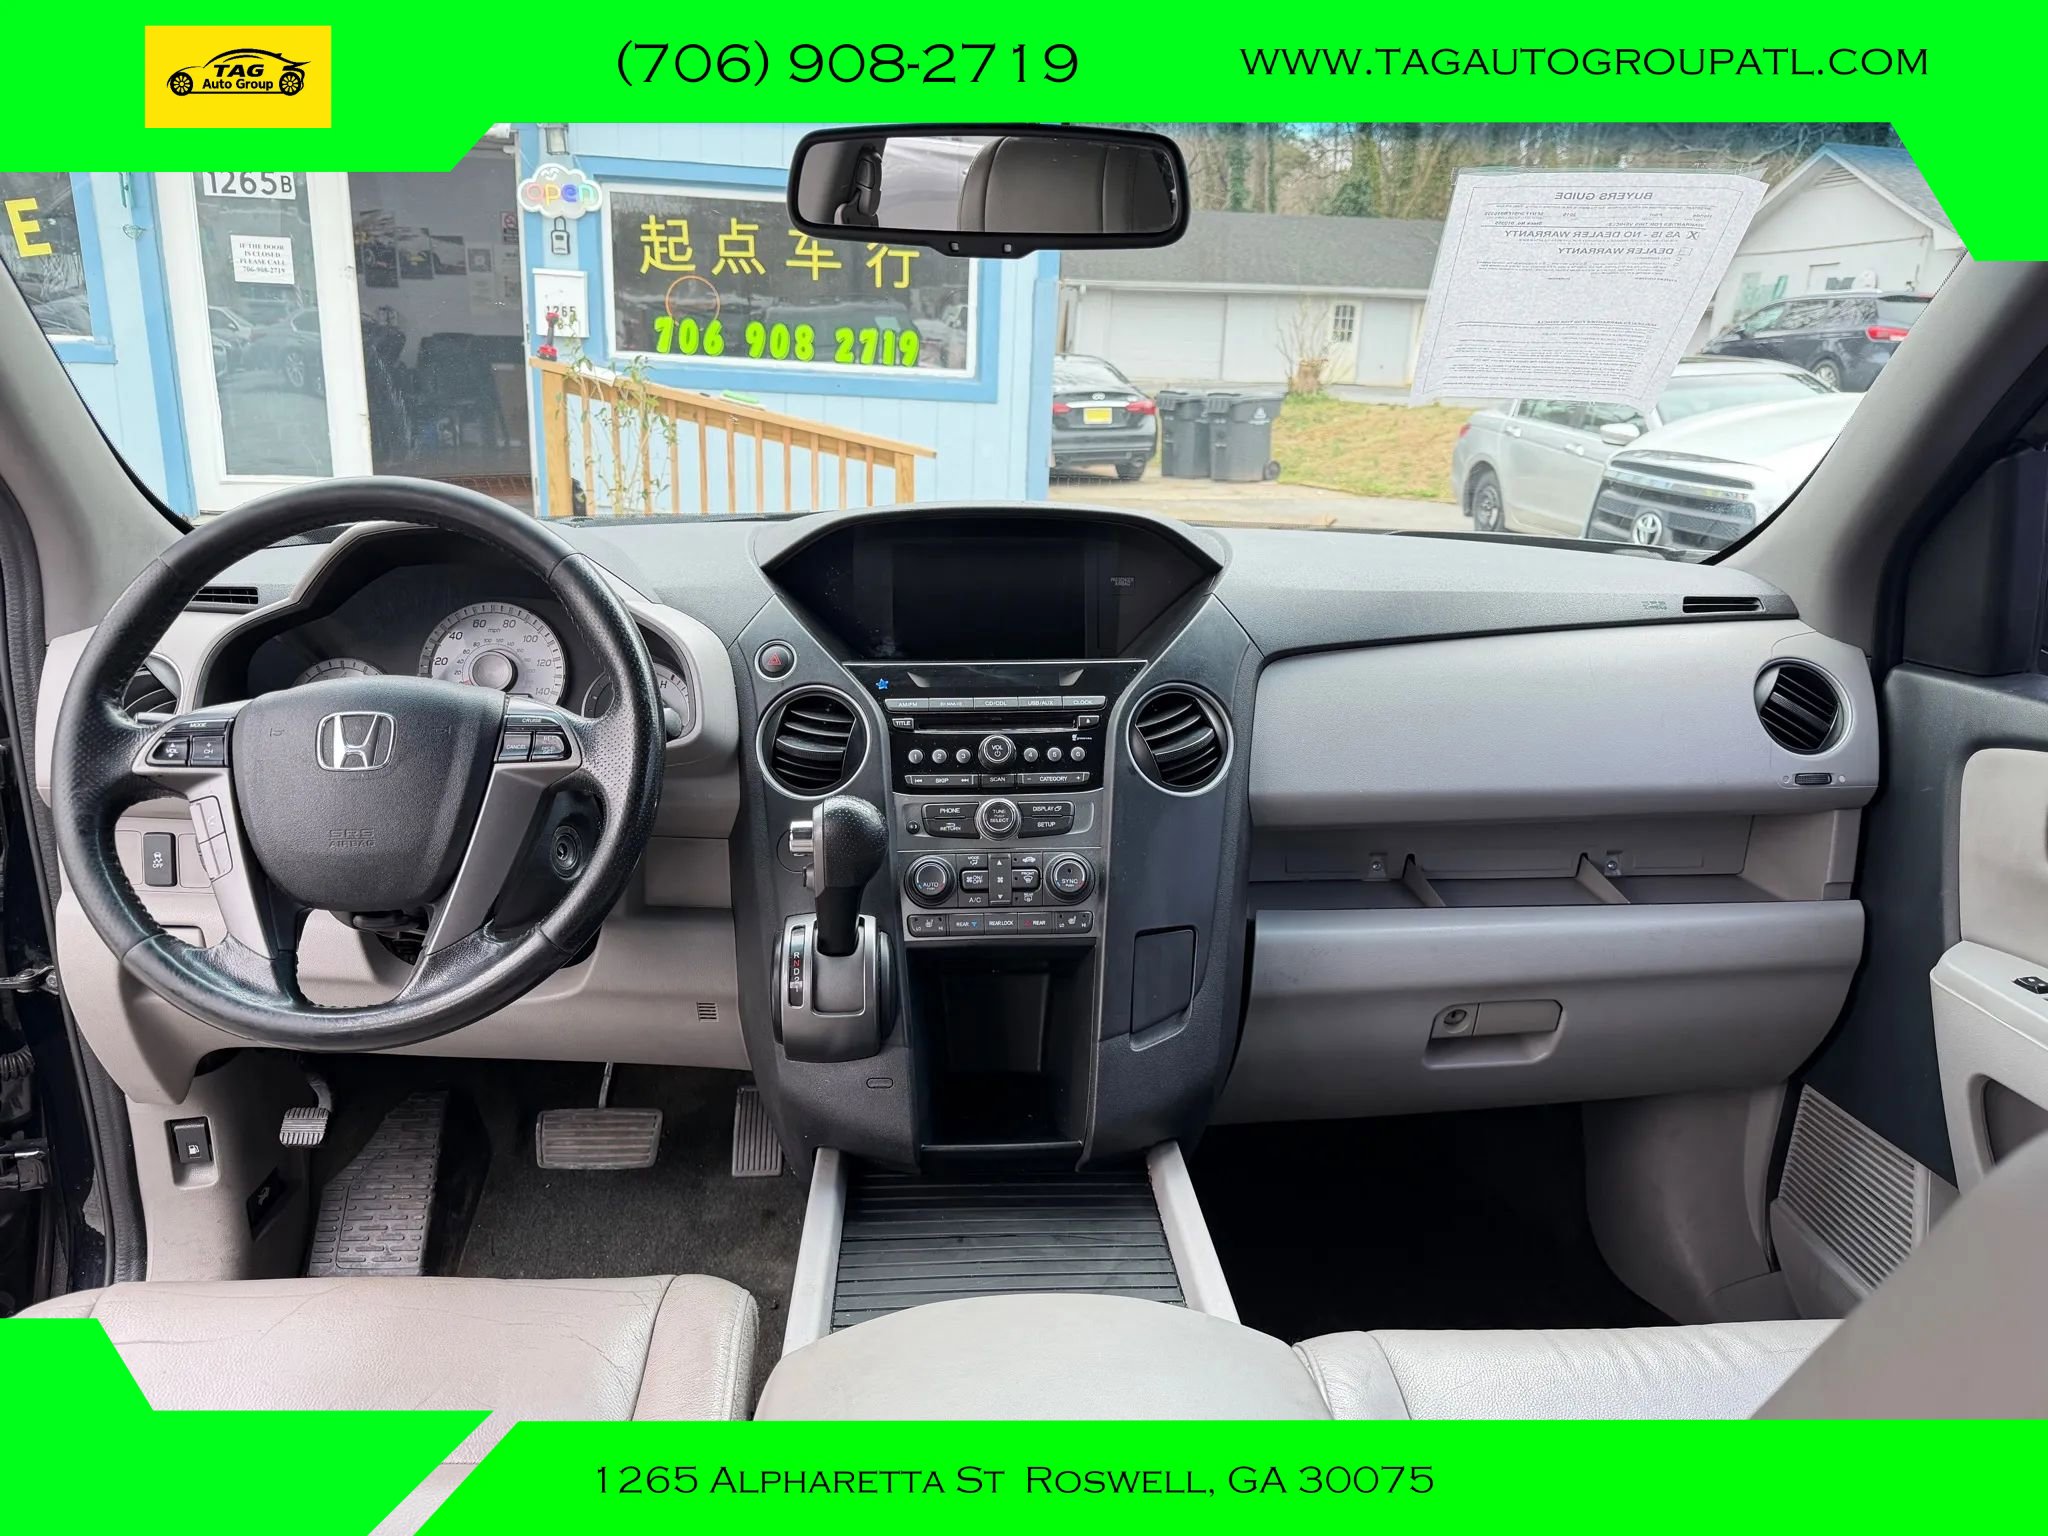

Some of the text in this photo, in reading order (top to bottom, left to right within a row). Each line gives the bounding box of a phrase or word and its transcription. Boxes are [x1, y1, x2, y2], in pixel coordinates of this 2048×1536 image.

[4, 197, 53, 258] E
[639, 214, 921, 289] 起点车行
[654, 315, 920, 367] 706 908 2719
[472, 619, 487, 628] 60
[502, 619, 517, 628] 80
[449, 631, 463, 640] 40
[523, 634, 538, 643] 100
[434, 657, 448, 666] 20
[536, 659, 551, 667] 120
[535, 687, 550, 695] 140
[793, 959, 800, 967] N
